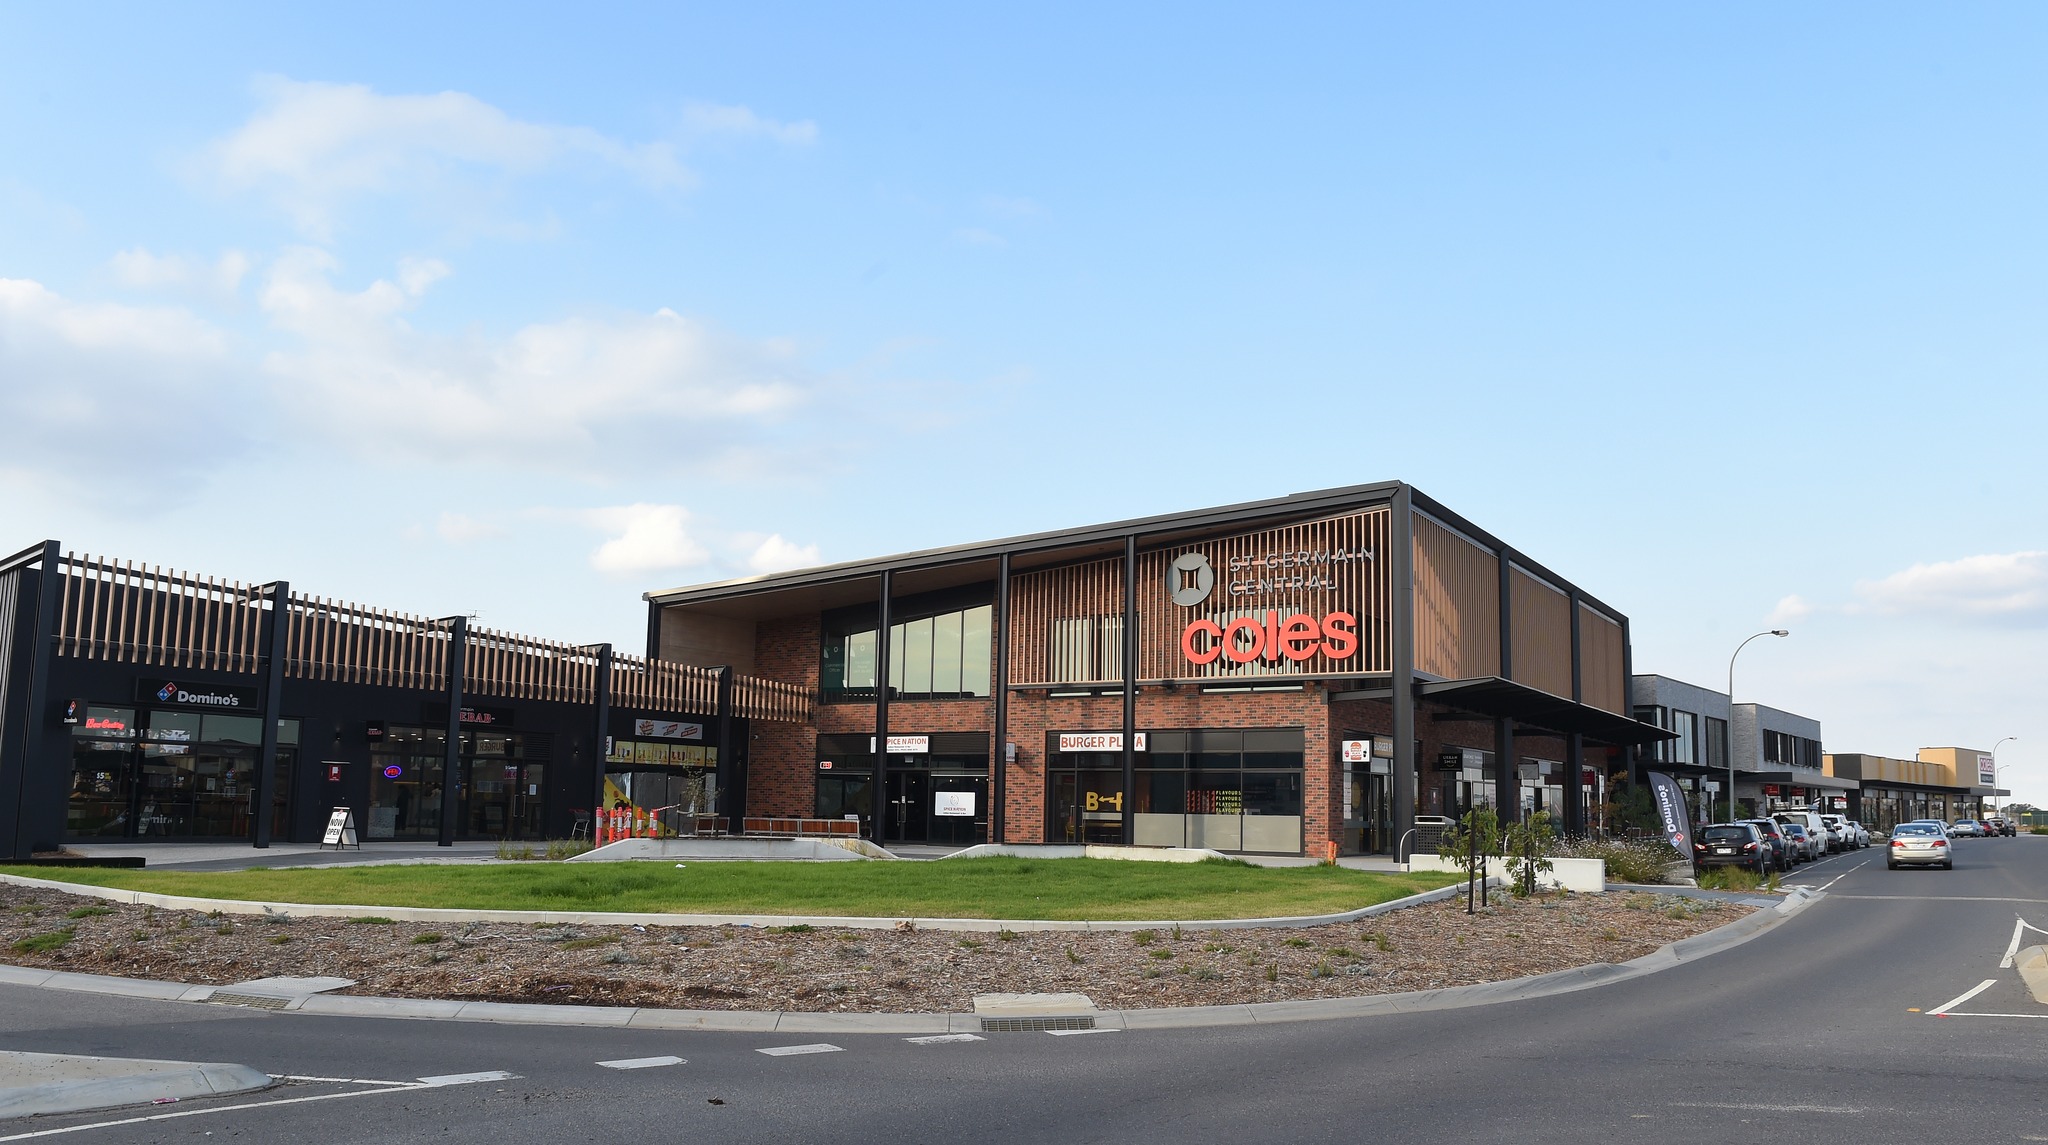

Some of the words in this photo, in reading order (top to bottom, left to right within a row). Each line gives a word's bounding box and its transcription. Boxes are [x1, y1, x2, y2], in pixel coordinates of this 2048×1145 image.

[1230, 555, 1254, 572] ST
[1264, 546, 1375, 570] GERMAIN
[1229, 574, 1336, 596] CENTRAL
[1181, 610, 1358, 665] coles
[177, 690, 239, 706] Domino's
[902, 737, 927, 745] NATION
[1061, 737, 1105, 748] BURGER
[1109, 736, 1143, 748] PLA
[329, 818, 345, 827] NOW
[326, 828, 341, 836] OPEN
